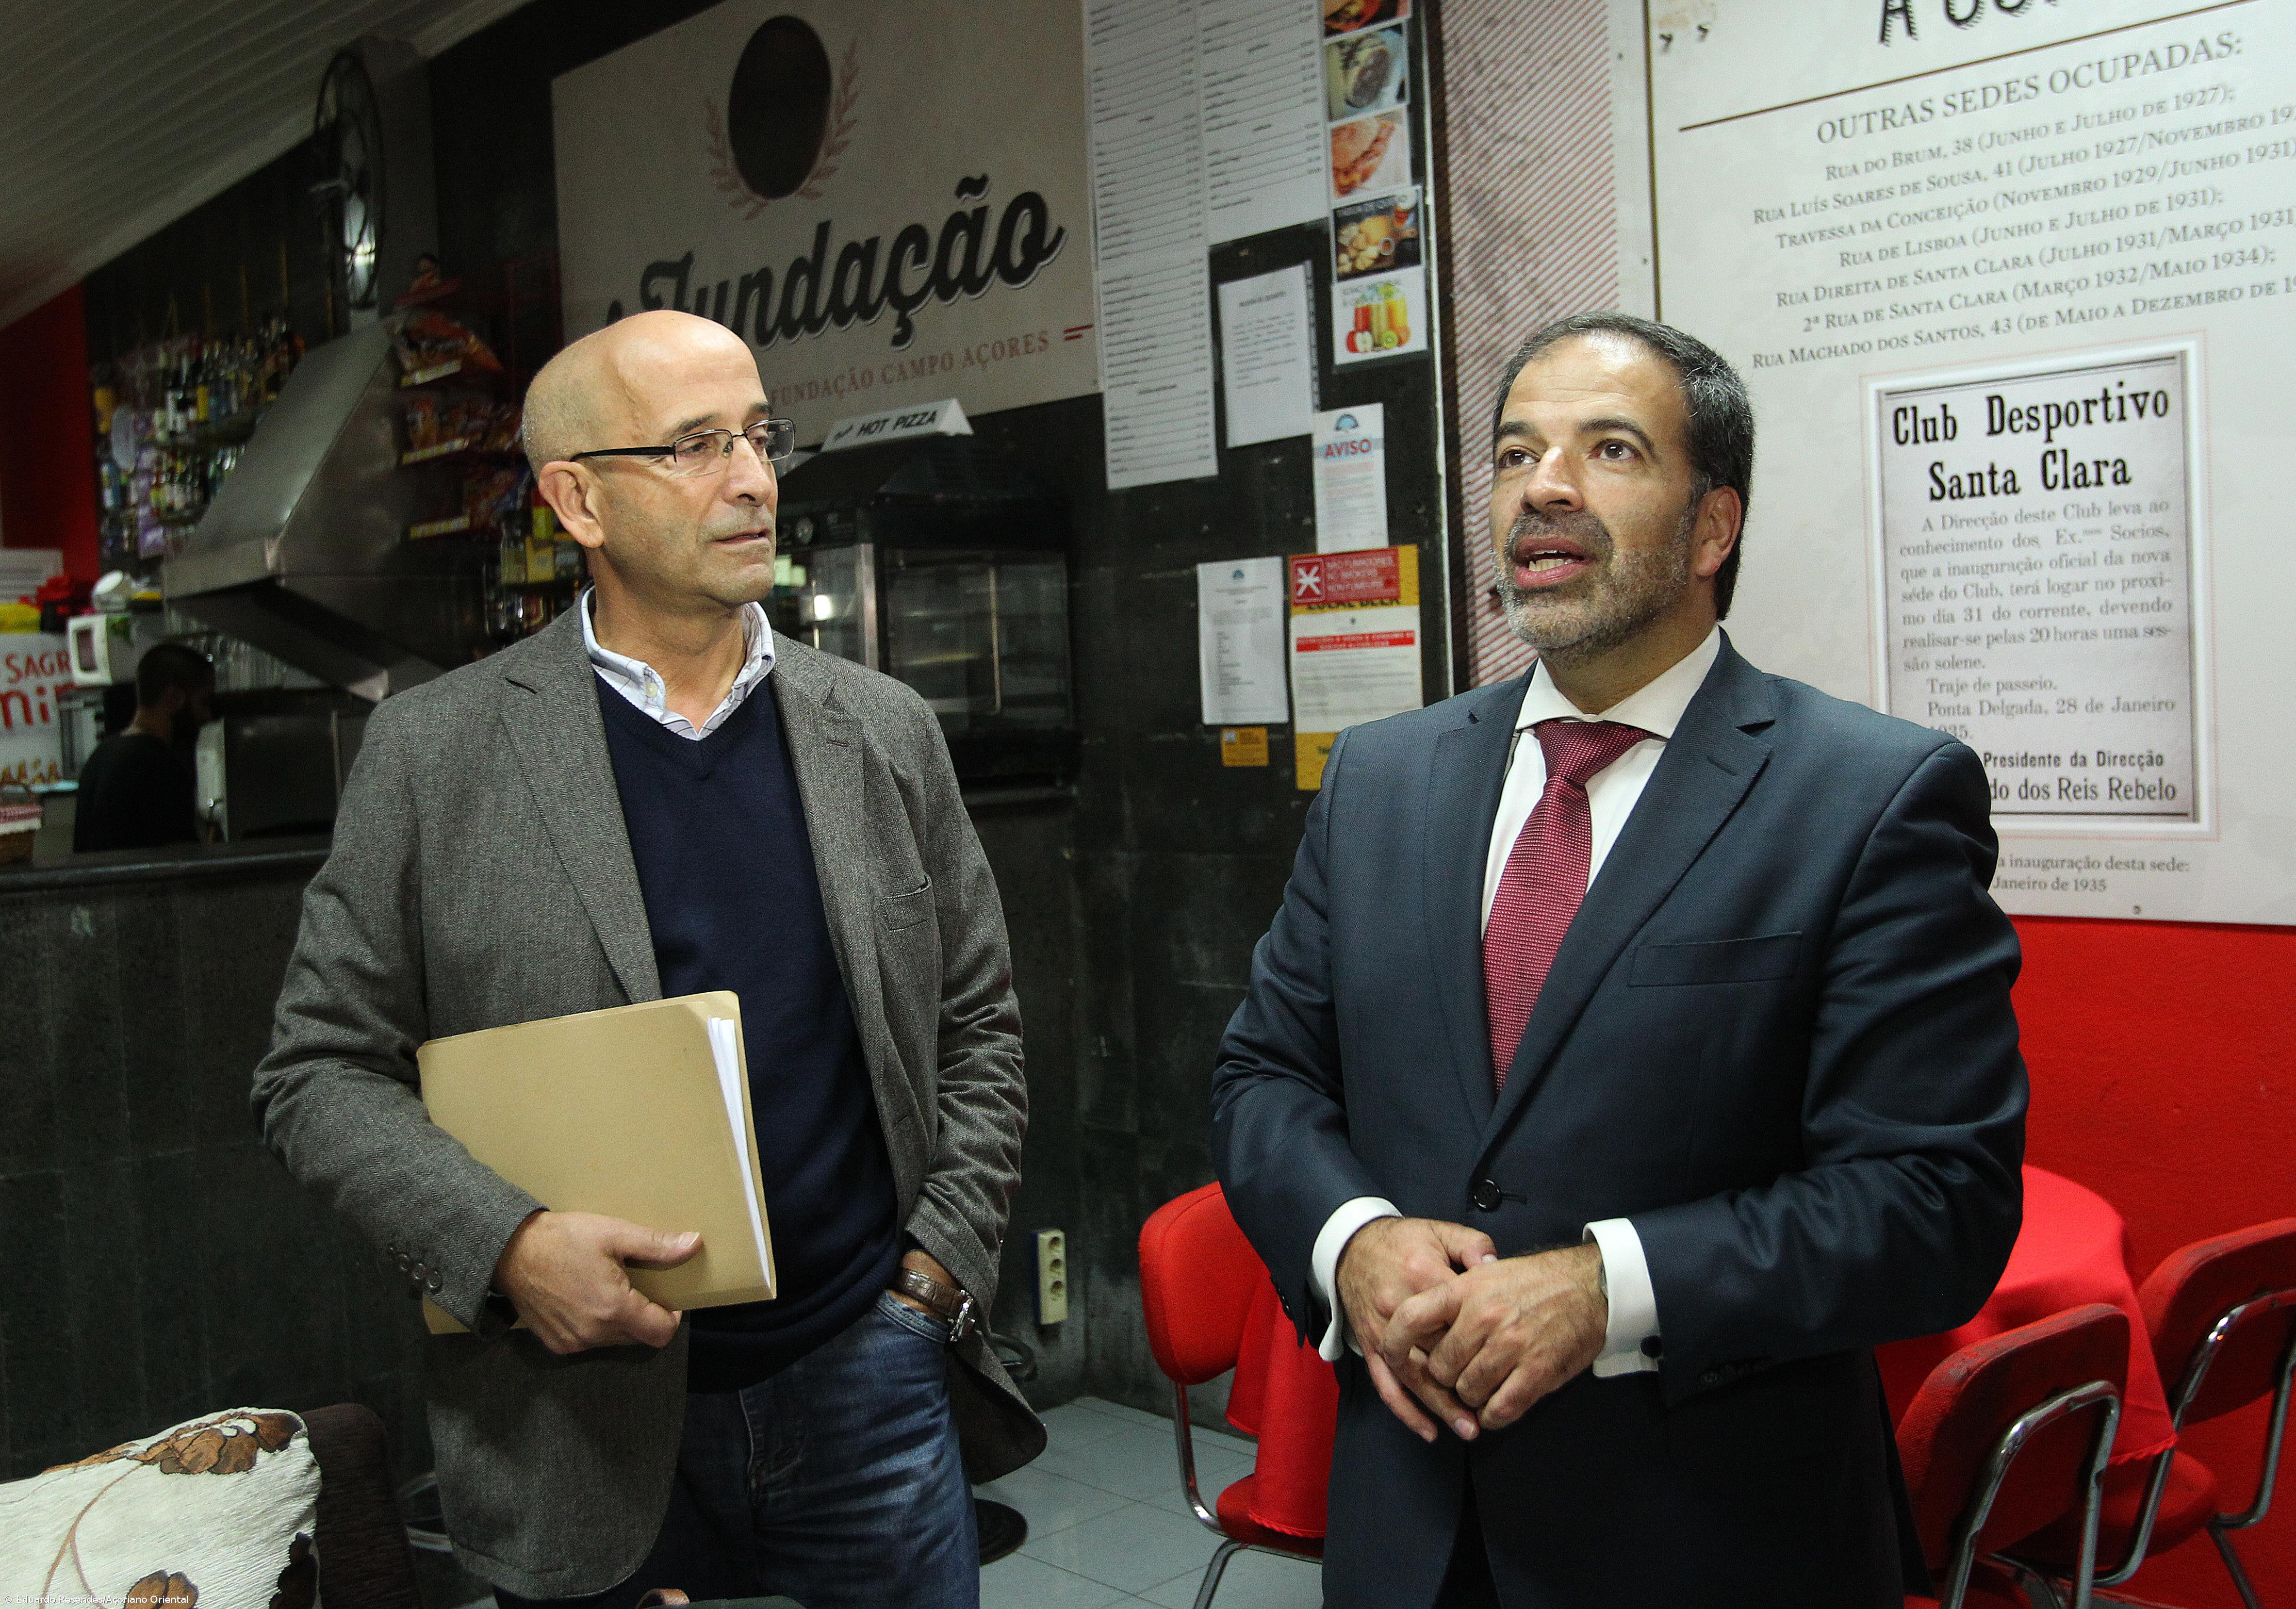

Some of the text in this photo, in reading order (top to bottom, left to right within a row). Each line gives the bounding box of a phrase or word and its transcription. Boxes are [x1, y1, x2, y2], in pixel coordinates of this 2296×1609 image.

[1817, 32, 2243, 143] OUTRAS SEDES OCUPADAS:
[1953, 137, 1971, 155] 38
[1993, 161, 2013, 178] 41
[2270, 104, 2296, 126] 19
[1991, 317, 2012, 336] 43
[880, 352, 955, 386] CAMPO
[962, 331, 1049, 369] AÇORES
[857, 411, 937, 438] HOT PIZZA
[1893, 381, 2170, 447] Club Desportivo
[1325, 439, 1372, 457] AVISO
[1928, 449, 2132, 501] Santa Clara
[1923, 500, 2170, 532] A Direcção deste Club leva ao
[1899, 537, 2003, 557] conhecimento
[1900, 550, 2170, 582] que a inauguração oficial da nova
[1940, 586, 1957, 600] do
[2010, 580, 2041, 596] terá
[2047, 578, 2087, 597] logar
[2095, 579, 2114, 590] no
[1903, 614, 1924, 626] mo
[1933, 609, 1955, 623] dia
[1963, 607, 1982, 622] 31
[1993, 605, 2010, 620] do
[2100, 597, 2172, 616] devendo
[1987, 629, 2025, 648] pelas
[2030, 627, 2049, 643] 20
[2052, 626, 2097, 641] horas
[2103, 628, 2138, 639] uma
[5, 650, 71, 683] SAGR
[1935, 654, 1986, 670] solene.
[1927, 676, 2058, 695] Traje de passeio.
[1928, 696, 2175, 719] Ponta Delgada, 28 de Janeiro
[1931, 724, 1973, 739] 35.
[1983, 750, 2163, 771] Presidente da Direcção
[1990, 778, 2176, 801] do dos Reis Rebelo
[2011, 855, 2100, 873] inauguração
[2105, 856, 2145, 871] desta
[2150, 858, 2189, 872] sede:
[1993, 876, 2106, 892] Janeiro de 1935
